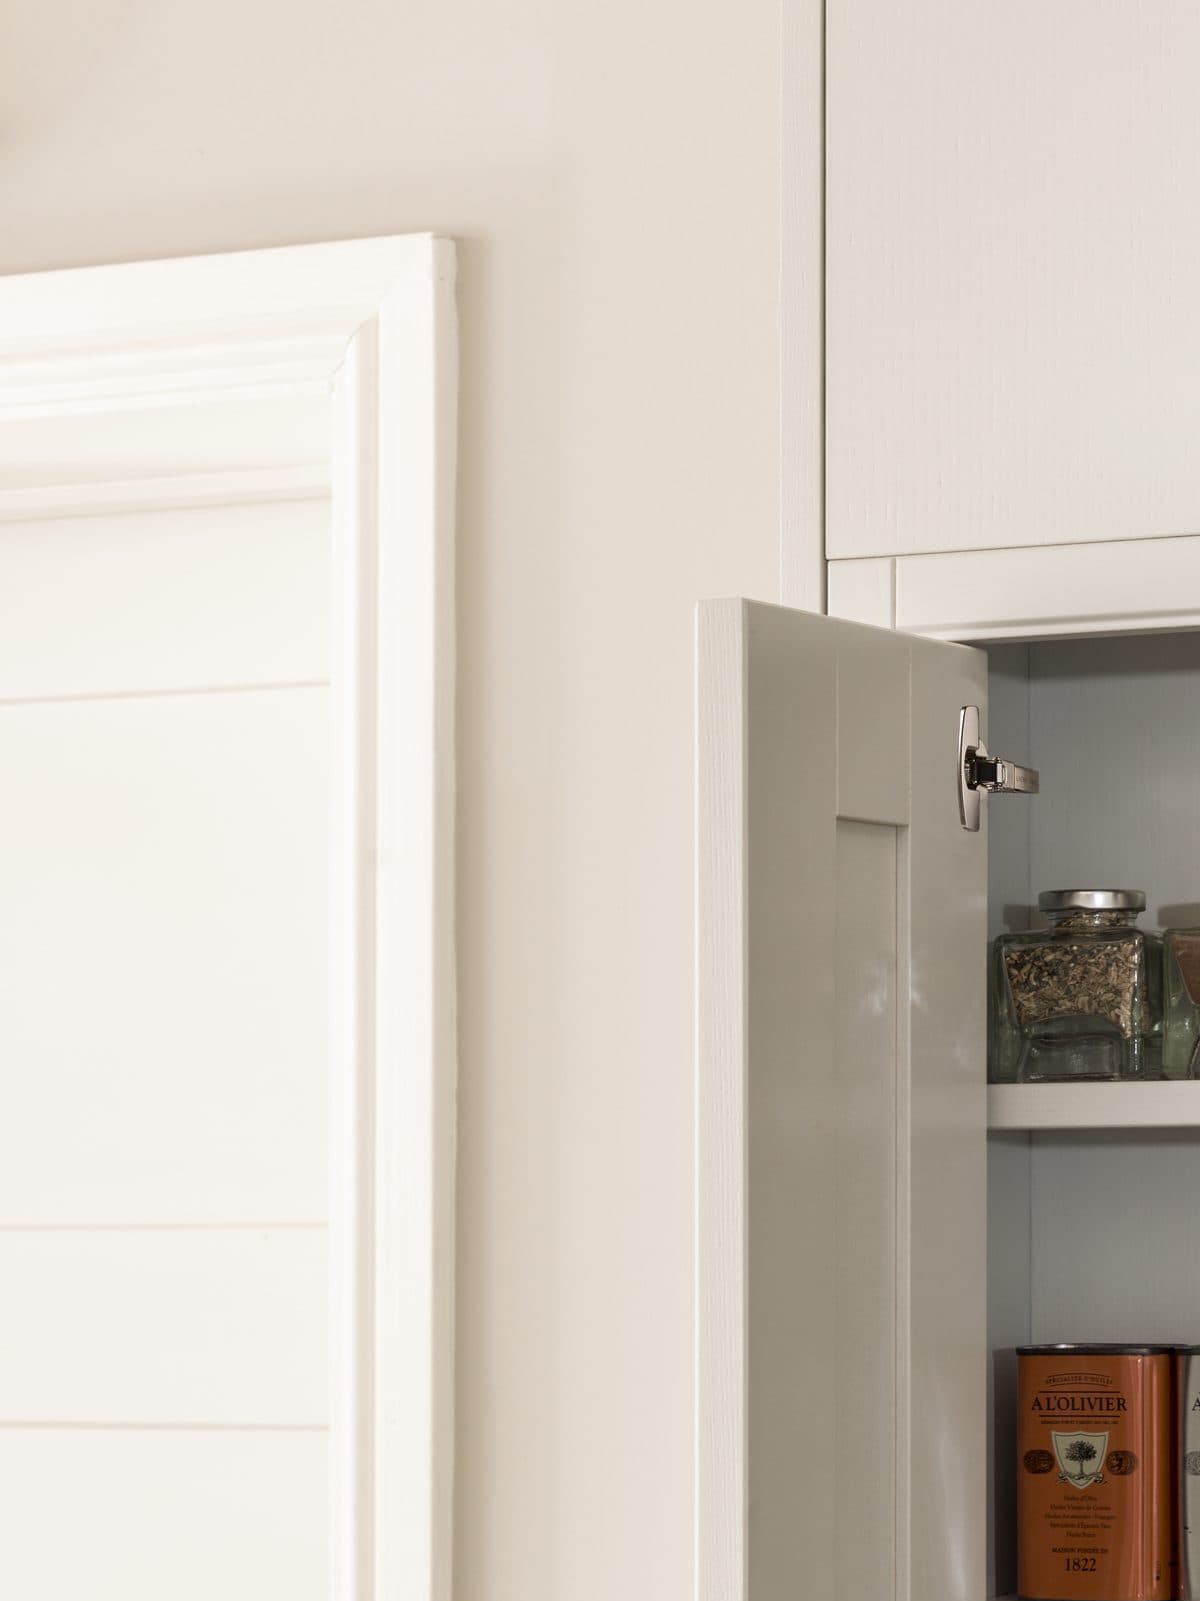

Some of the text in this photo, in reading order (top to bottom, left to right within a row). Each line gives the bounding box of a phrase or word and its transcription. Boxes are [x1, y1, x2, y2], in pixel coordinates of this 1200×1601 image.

[1031, 1395, 1128, 1412] A L'OLIVIER
[1064, 1557, 1097, 1572] 1822
